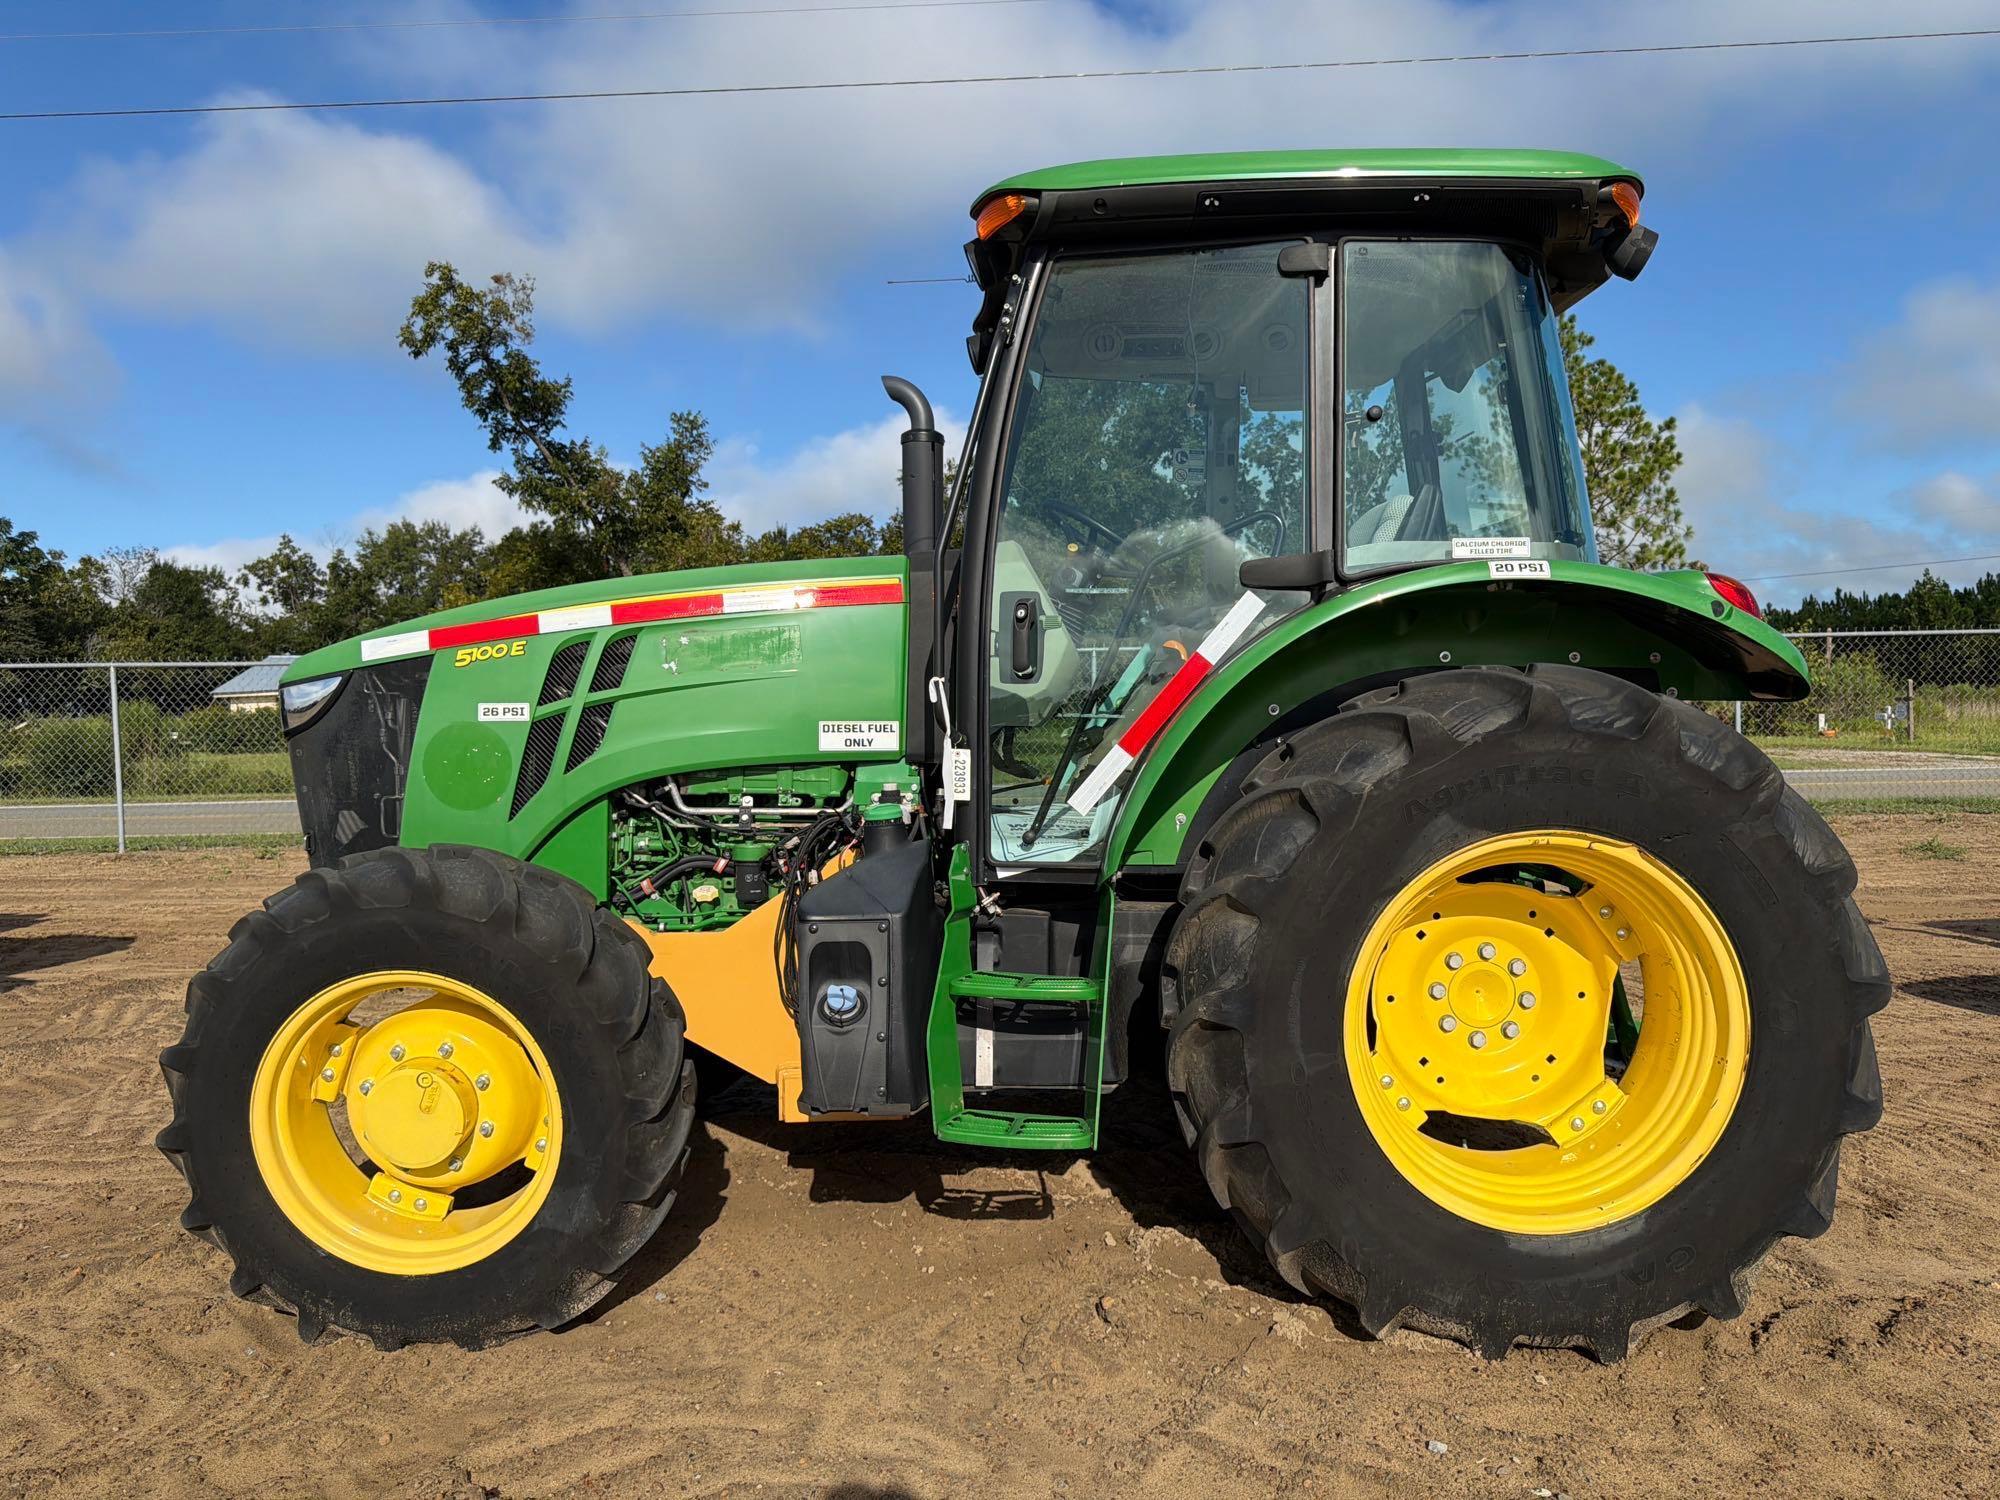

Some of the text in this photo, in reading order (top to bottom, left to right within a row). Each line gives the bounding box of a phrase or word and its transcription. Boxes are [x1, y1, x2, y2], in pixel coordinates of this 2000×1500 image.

[1494, 563, 1545, 573] 20 PSI
[482, 707, 525, 717] 26 PSI
[822, 723, 896, 733] DIESEL FUEL
[844, 738, 874, 748] ONLY
[954, 759, 966, 794] 223933
